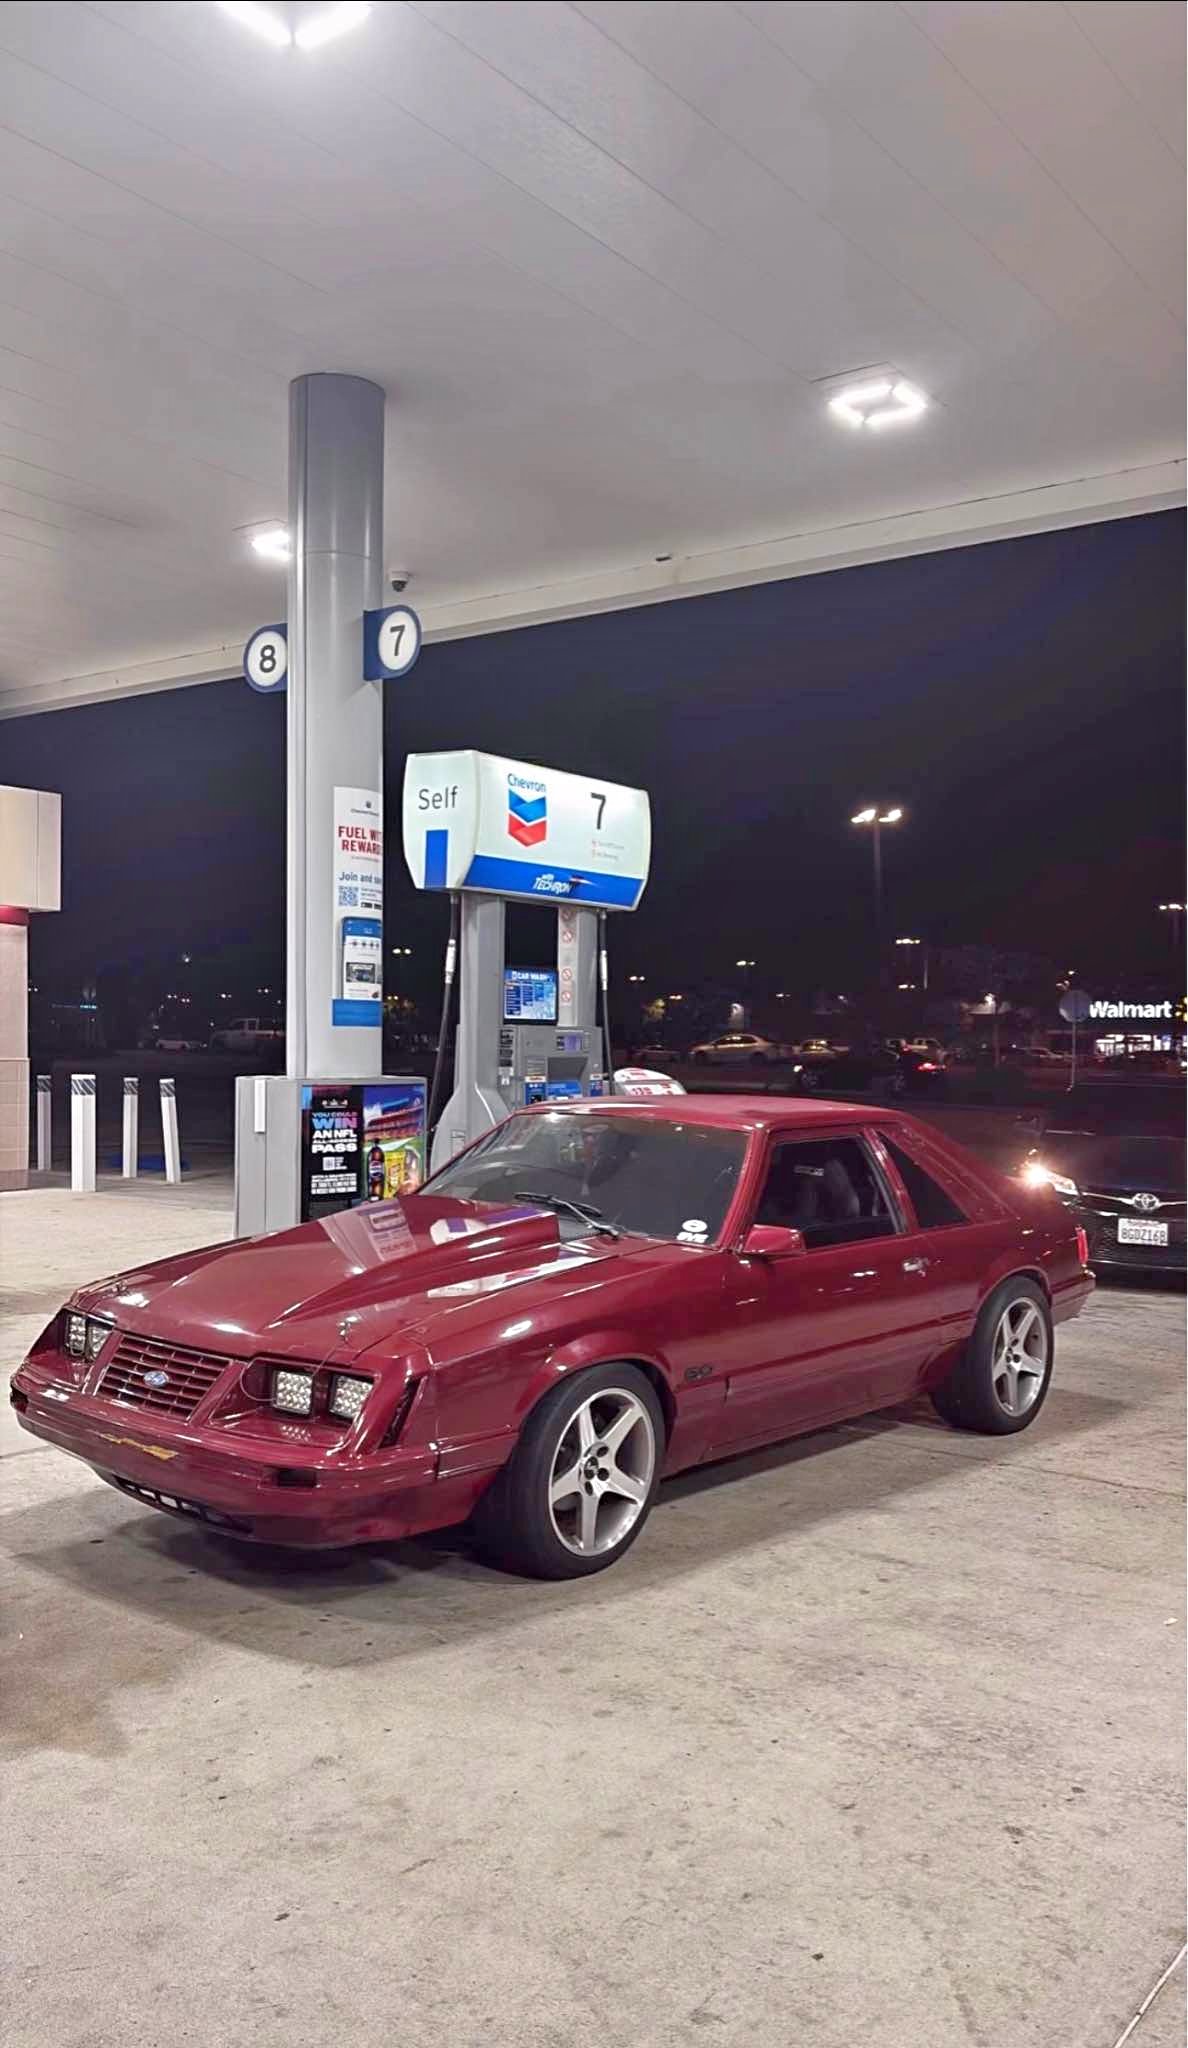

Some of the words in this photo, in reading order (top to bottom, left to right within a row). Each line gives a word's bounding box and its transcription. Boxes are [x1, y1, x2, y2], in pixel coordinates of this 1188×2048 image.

[389, 624, 406, 657] 7
[259, 644, 277, 673] 8
[507, 772, 547, 792] Chevron
[417, 785, 459, 810] Self
[590, 791, 607, 830] 7
[338, 825, 367, 840] FUEL
[339, 871, 359, 882] Join
[1089, 1000, 1173, 1018] Walmart
[312, 1117, 358, 1129] WIN
[312, 1129, 333, 1139] AN
[334, 1129, 358, 1138] NFL
[311, 1143, 358, 1154] PASS
